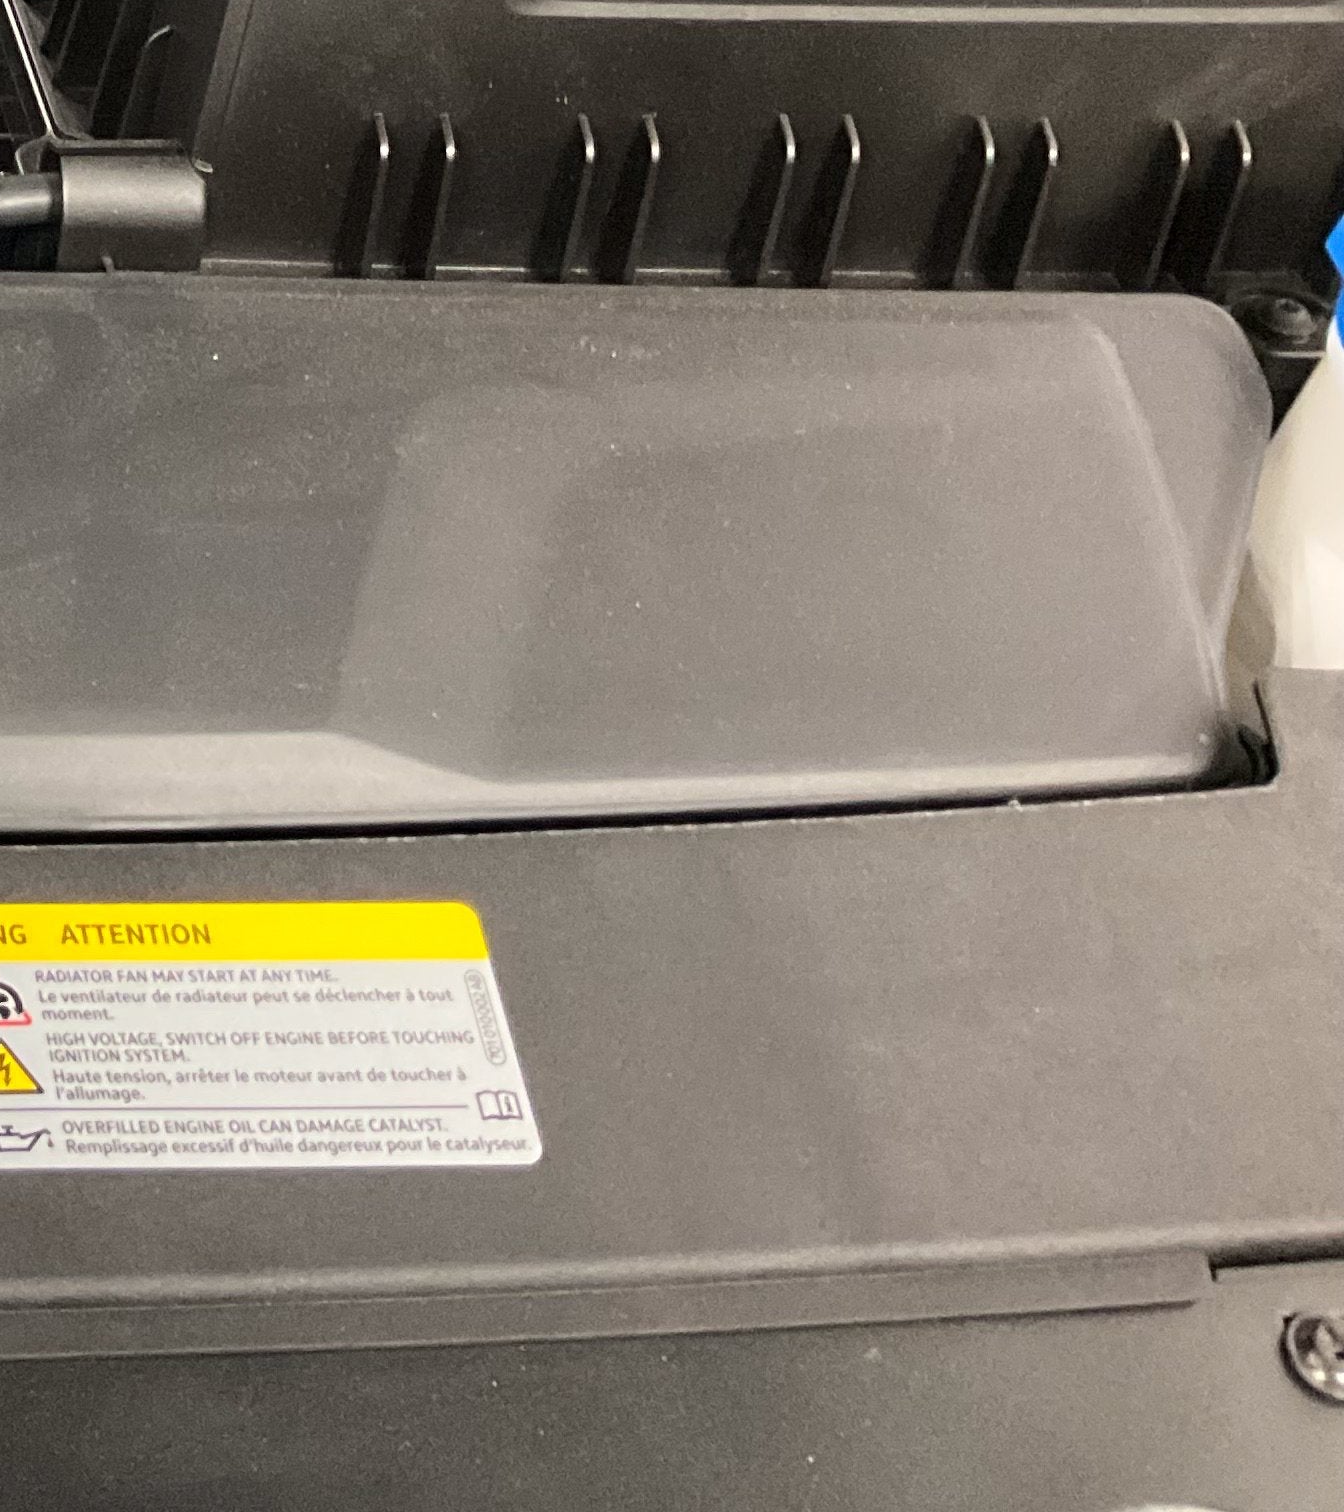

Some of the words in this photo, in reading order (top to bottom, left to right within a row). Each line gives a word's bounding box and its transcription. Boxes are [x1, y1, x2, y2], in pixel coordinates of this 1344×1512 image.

[61, 923, 212, 945] ATTENTION
[35, 969, 113, 983] RADIATOR
[117, 969, 148, 983] FAN
[153, 969, 185, 983] MAY
[189, 969, 234, 982] START
[262, 969, 292, 982] ANY
[295, 969, 339, 982] TIME.
[38, 990, 56, 1004] Le
[61, 990, 147, 1004] ventilateur
[152, 989, 171, 1003] de
[176, 990, 247, 1003] radiateur
[253, 990, 288, 1005] peut
[315, 988, 401, 1002] déclencher
[419, 989, 454, 1002] tout
[42, 1008, 115, 1021] moment.
[46, 1032, 84, 1046] HIGH
[88, 1032, 162, 1047] VOLTAGE,
[167, 1032, 226, 1046] SWITCH
[231, 1032, 260, 1045] OFF
[265, 1031, 324, 1045] ENGINE
[328, 1031, 388, 1045] BEFORE
[392, 1031, 475, 1045] TOUCHING
[49, 1049, 121, 1063] IGNITION
[124, 1049, 190, 1063] SYSTEM.
[53, 1070, 101, 1084] Haute
[106, 1071, 172, 1086] tension,
[176, 1070, 231, 1083] arrêter
[254, 1069, 312, 1083] moteur
[317, 1070, 362, 1083] avant
[367, 1068, 386, 1082] de
[391, 1068, 451, 1082] toucher
[56, 1086, 145, 1103] l'allumage.
[62, 1120, 160, 1135] OVERFILLED
[164, 1120, 225, 1134] ENGINE
[229, 1119, 256, 1133] OIL
[260, 1119, 293, 1133] CAN
[296, 1118, 363, 1133] DAMAGE
[368, 1118, 448, 1132] CATALYST.
[66, 1138, 165, 1156] Remplissage
[173, 1137, 235, 1153] excessif
[239, 1137, 293, 1152] d'huile
[298, 1138, 383, 1155] dangereux
[387, 1140, 423, 1154] pour
[446, 1137, 532, 1154] catalyseur.
